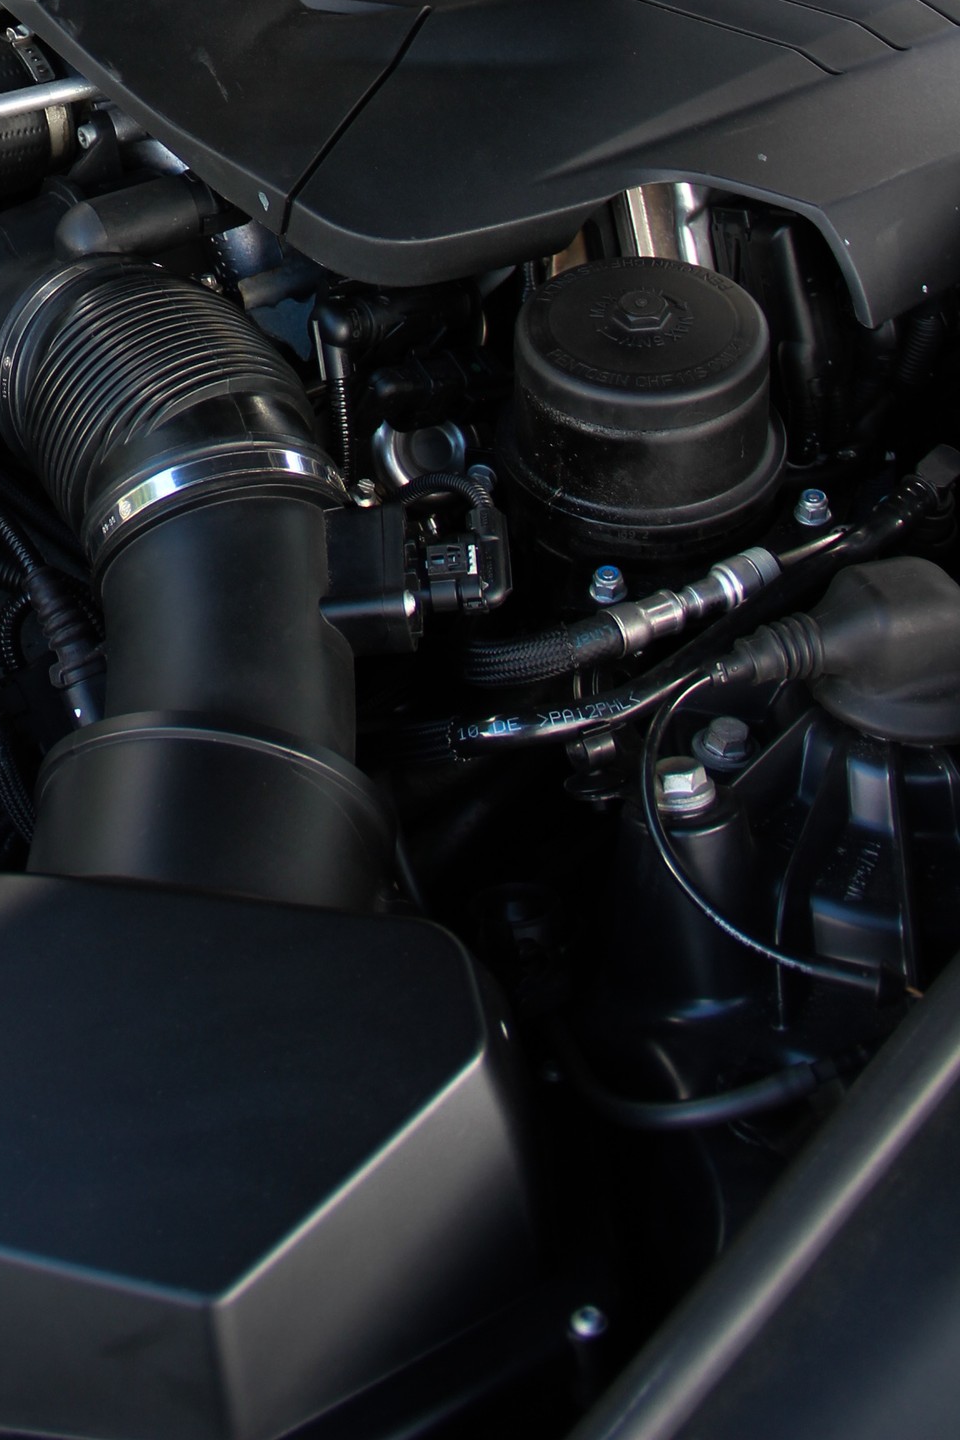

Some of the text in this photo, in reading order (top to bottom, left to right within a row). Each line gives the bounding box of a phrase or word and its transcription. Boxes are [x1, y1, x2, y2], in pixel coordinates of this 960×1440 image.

[546, 347, 631, 386] PENTOSIN
[635, 373, 673, 388] CHF
[676, 366, 708, 385] 11S
[457, 724, 479, 740] 10
[492, 717, 522, 734] DE
